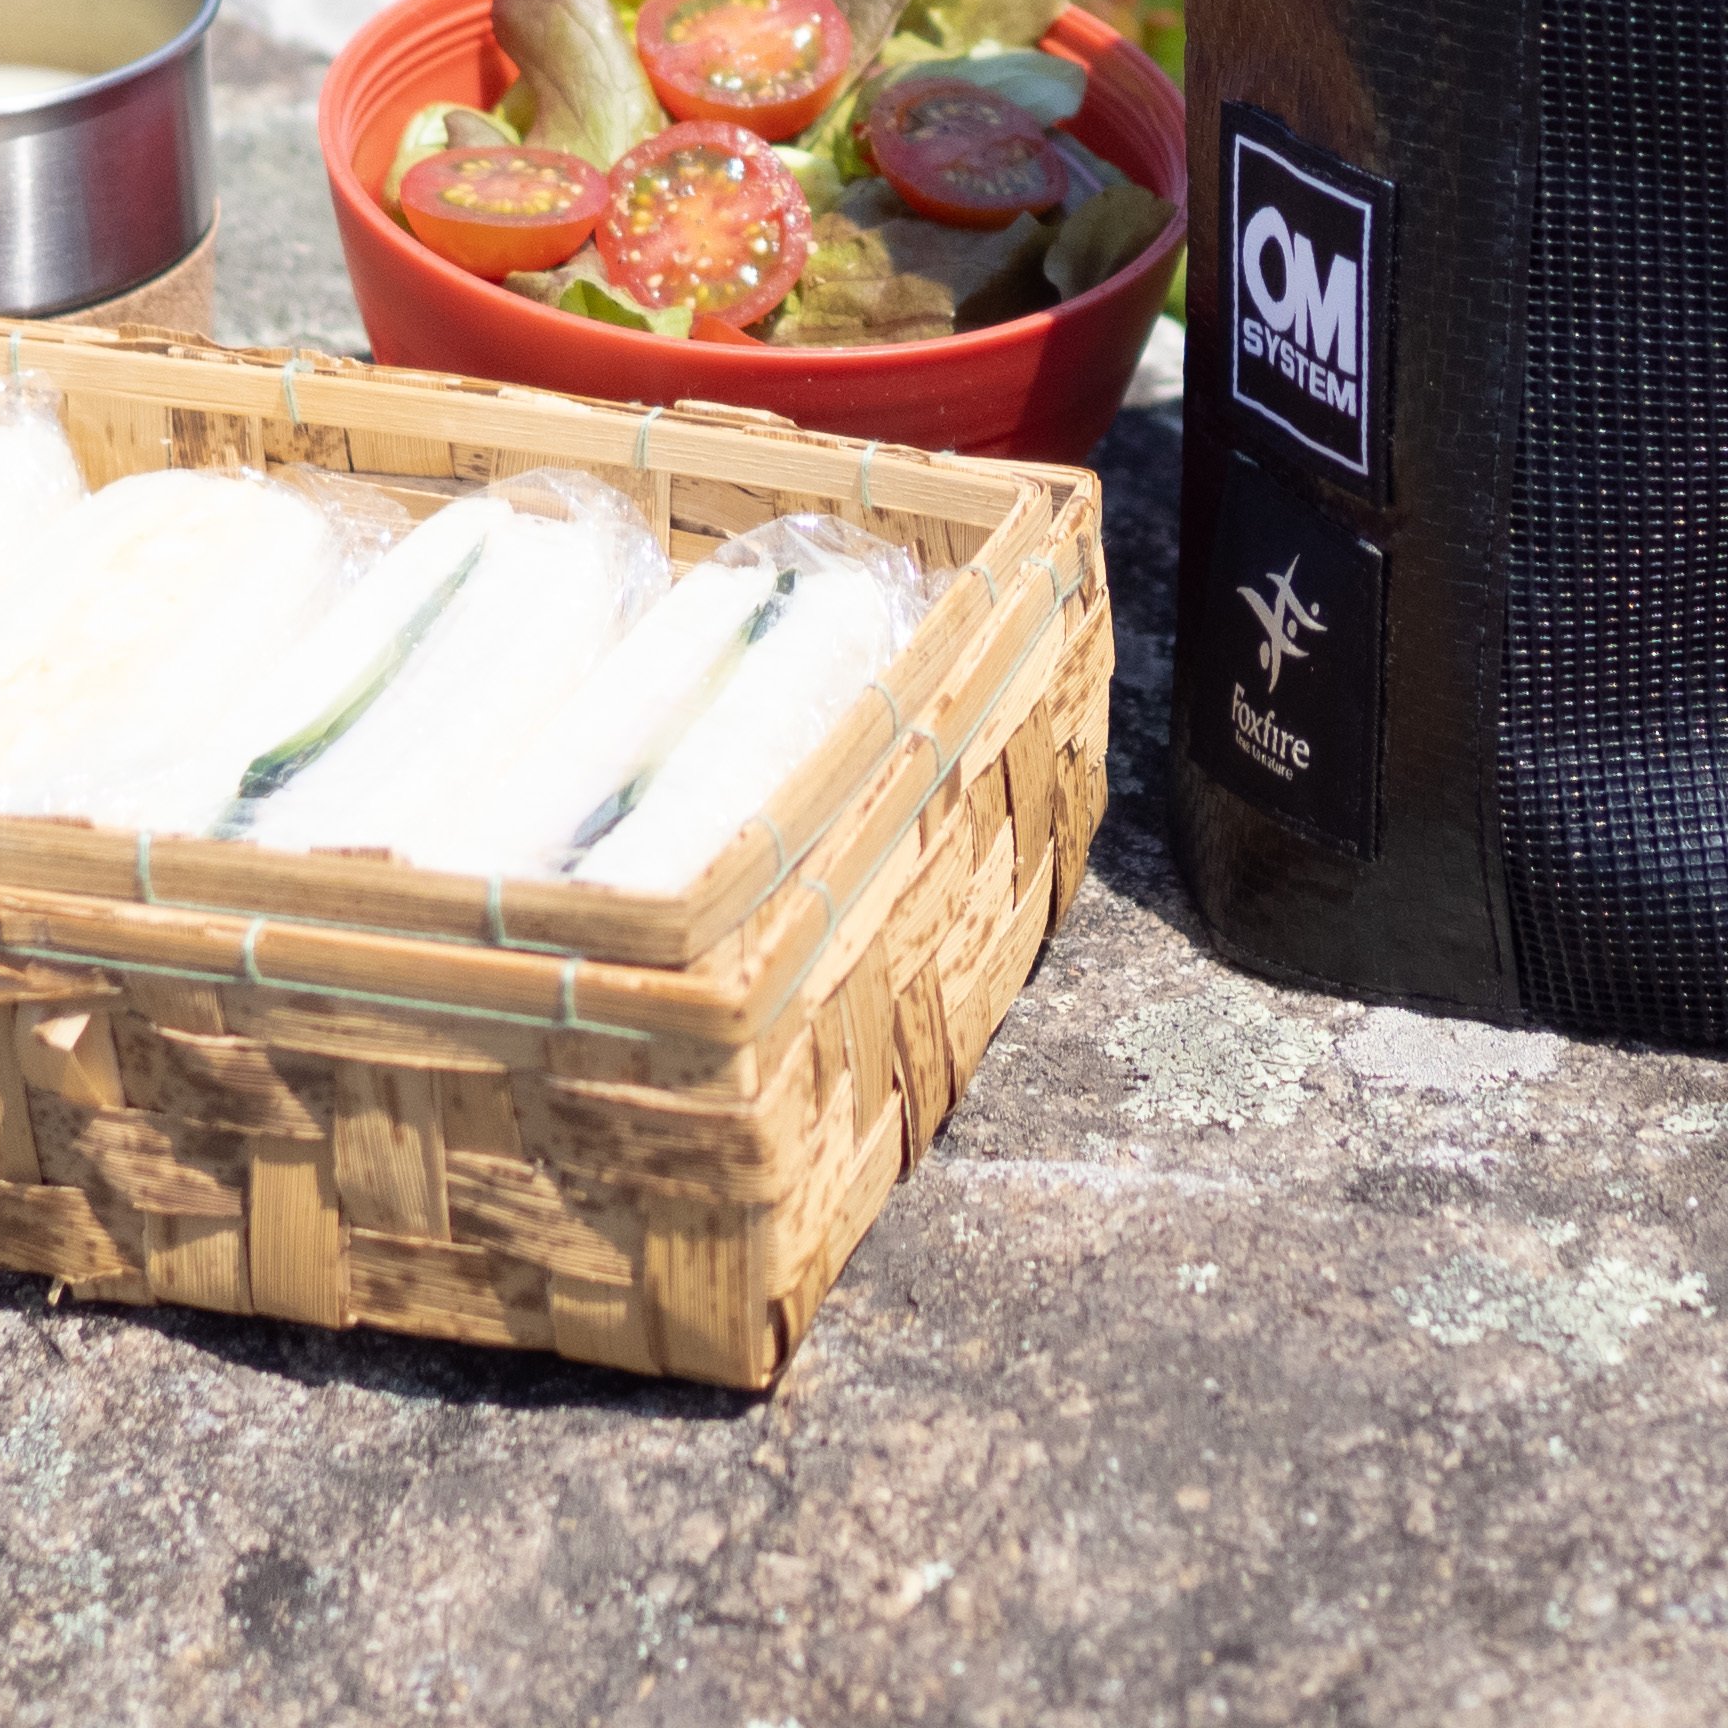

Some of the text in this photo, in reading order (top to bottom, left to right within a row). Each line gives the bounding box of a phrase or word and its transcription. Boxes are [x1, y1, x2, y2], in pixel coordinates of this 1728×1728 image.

[1243, 206, 1357, 376] OM
[1243, 318, 1357, 418] SYSTEM
[1232, 682, 1310, 769] Foxfire
